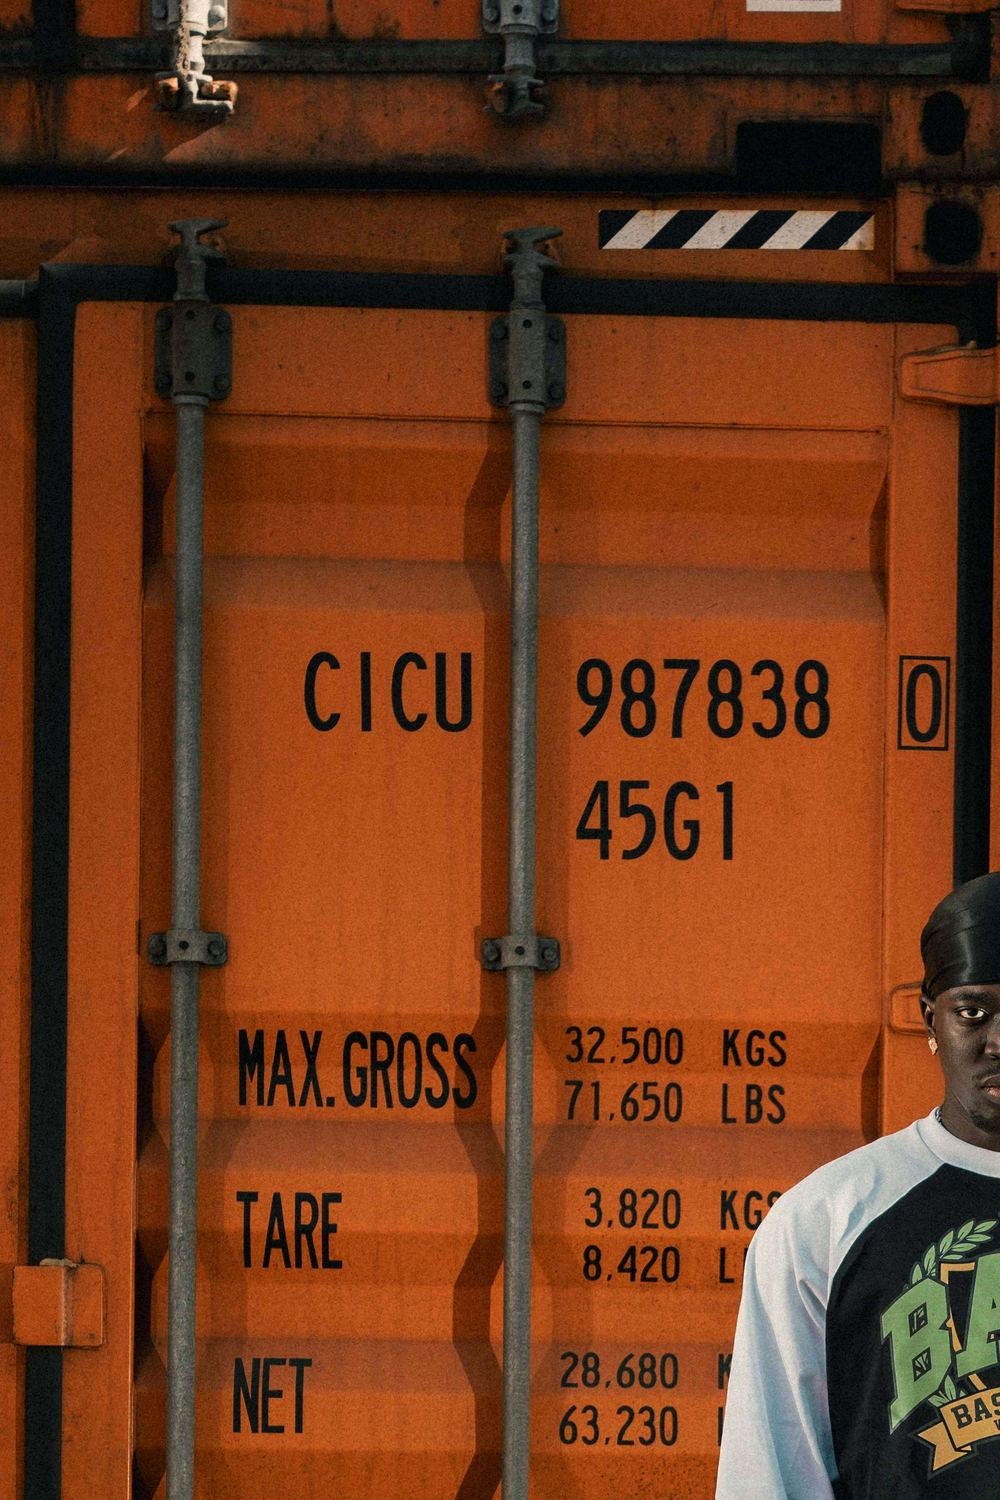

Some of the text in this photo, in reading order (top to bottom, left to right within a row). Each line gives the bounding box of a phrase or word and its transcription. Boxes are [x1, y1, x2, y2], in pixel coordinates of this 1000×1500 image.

[304, 652, 473, 732] CICU
[576, 658, 831, 739] 987838
[576, 780, 735, 861] 45G1
[722, 1029, 788, 1068] KGS
[721, 1083, 786, 1124] LBS
[236, 1191, 343, 1269] TARE
[232, 1357, 312, 1434] NET
